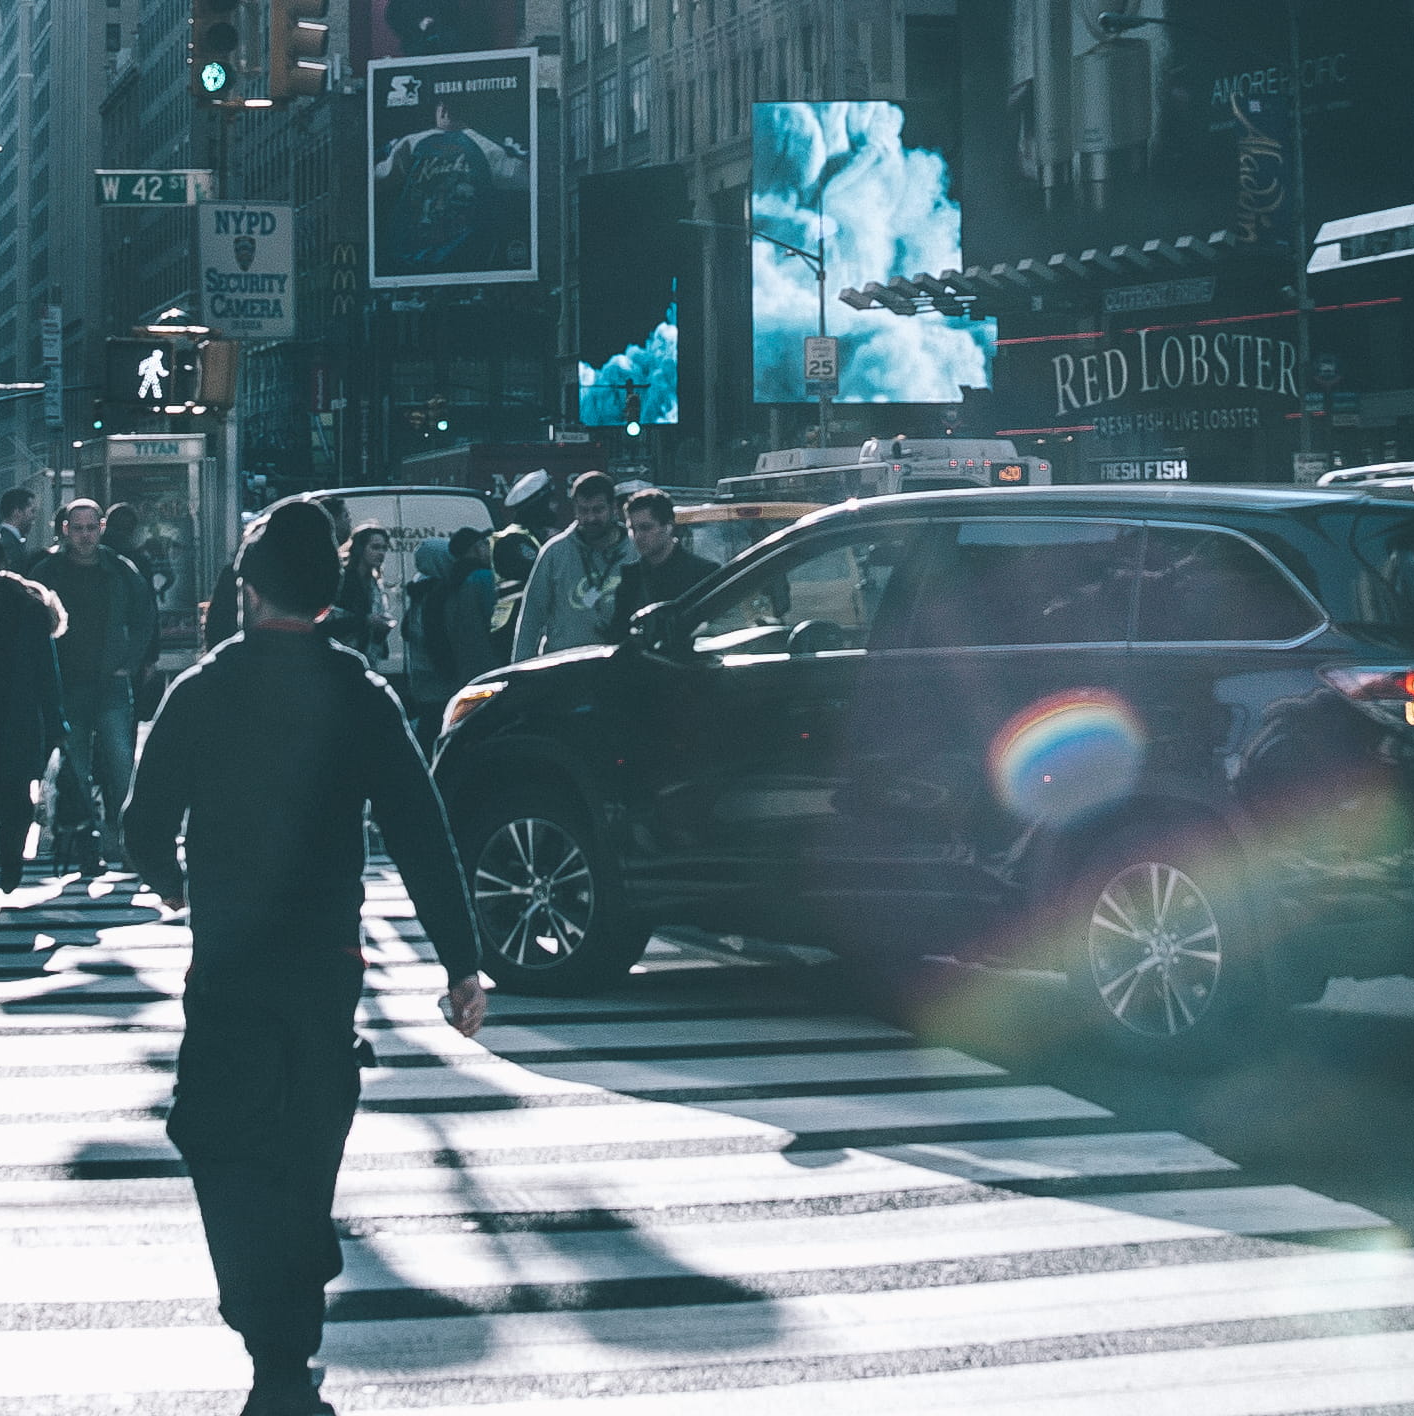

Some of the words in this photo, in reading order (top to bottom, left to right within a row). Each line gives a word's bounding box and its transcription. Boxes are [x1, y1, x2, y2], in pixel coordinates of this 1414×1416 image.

[101, 176, 121, 202] W
[131, 175, 163, 202] 42
[168, 176, 187, 190] ST
[214, 210, 277, 236] NYPD
[205, 267, 289, 294] SECURITY
[210, 293, 284, 320] CAMERA
[809, 360, 833, 376] 25
[1051, 349, 1129, 416] RED
[1137, 328, 1300, 400] LOBSTER
[1203, 406, 1261, 430] LOBSTER
[134, 441, 179, 455] TITAN
[1099, 461, 1140, 480] FRESH
[1143, 460, 1188, 480] FISH
